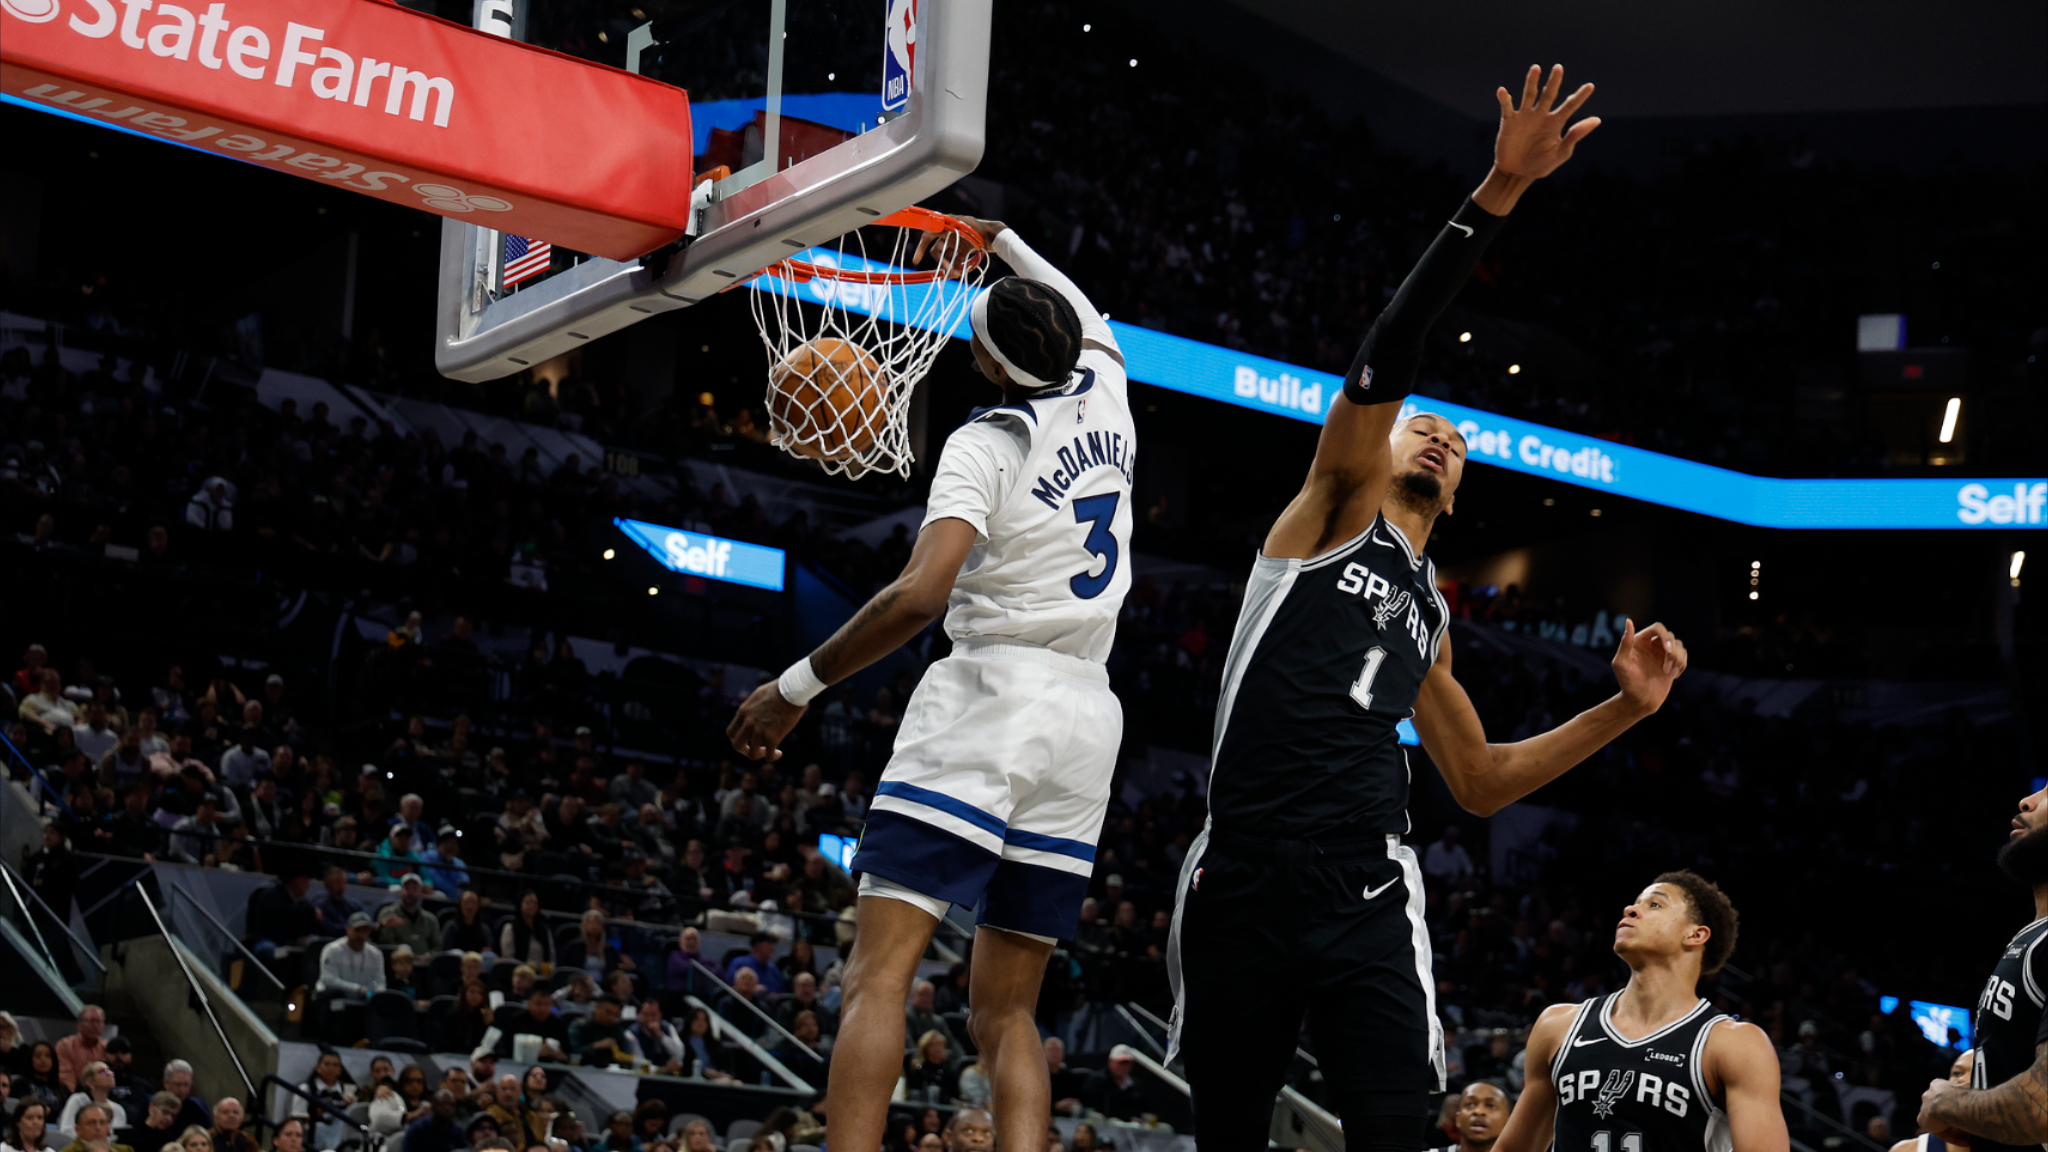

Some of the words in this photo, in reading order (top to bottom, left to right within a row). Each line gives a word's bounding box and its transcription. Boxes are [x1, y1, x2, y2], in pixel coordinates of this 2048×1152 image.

[887, 74, 904, 101] NBA
[1234, 365, 1323, 414] Build
[1456, 420, 1512, 459] Get
[1518, 434, 1614, 483] Credit
[1957, 482, 2048, 525] Self
[664, 531, 732, 577] Self
[1069, 490, 1121, 600] 3
[1349, 646, 1387, 711] 1
[1649, 1051, 1681, 1064] LEDGER
